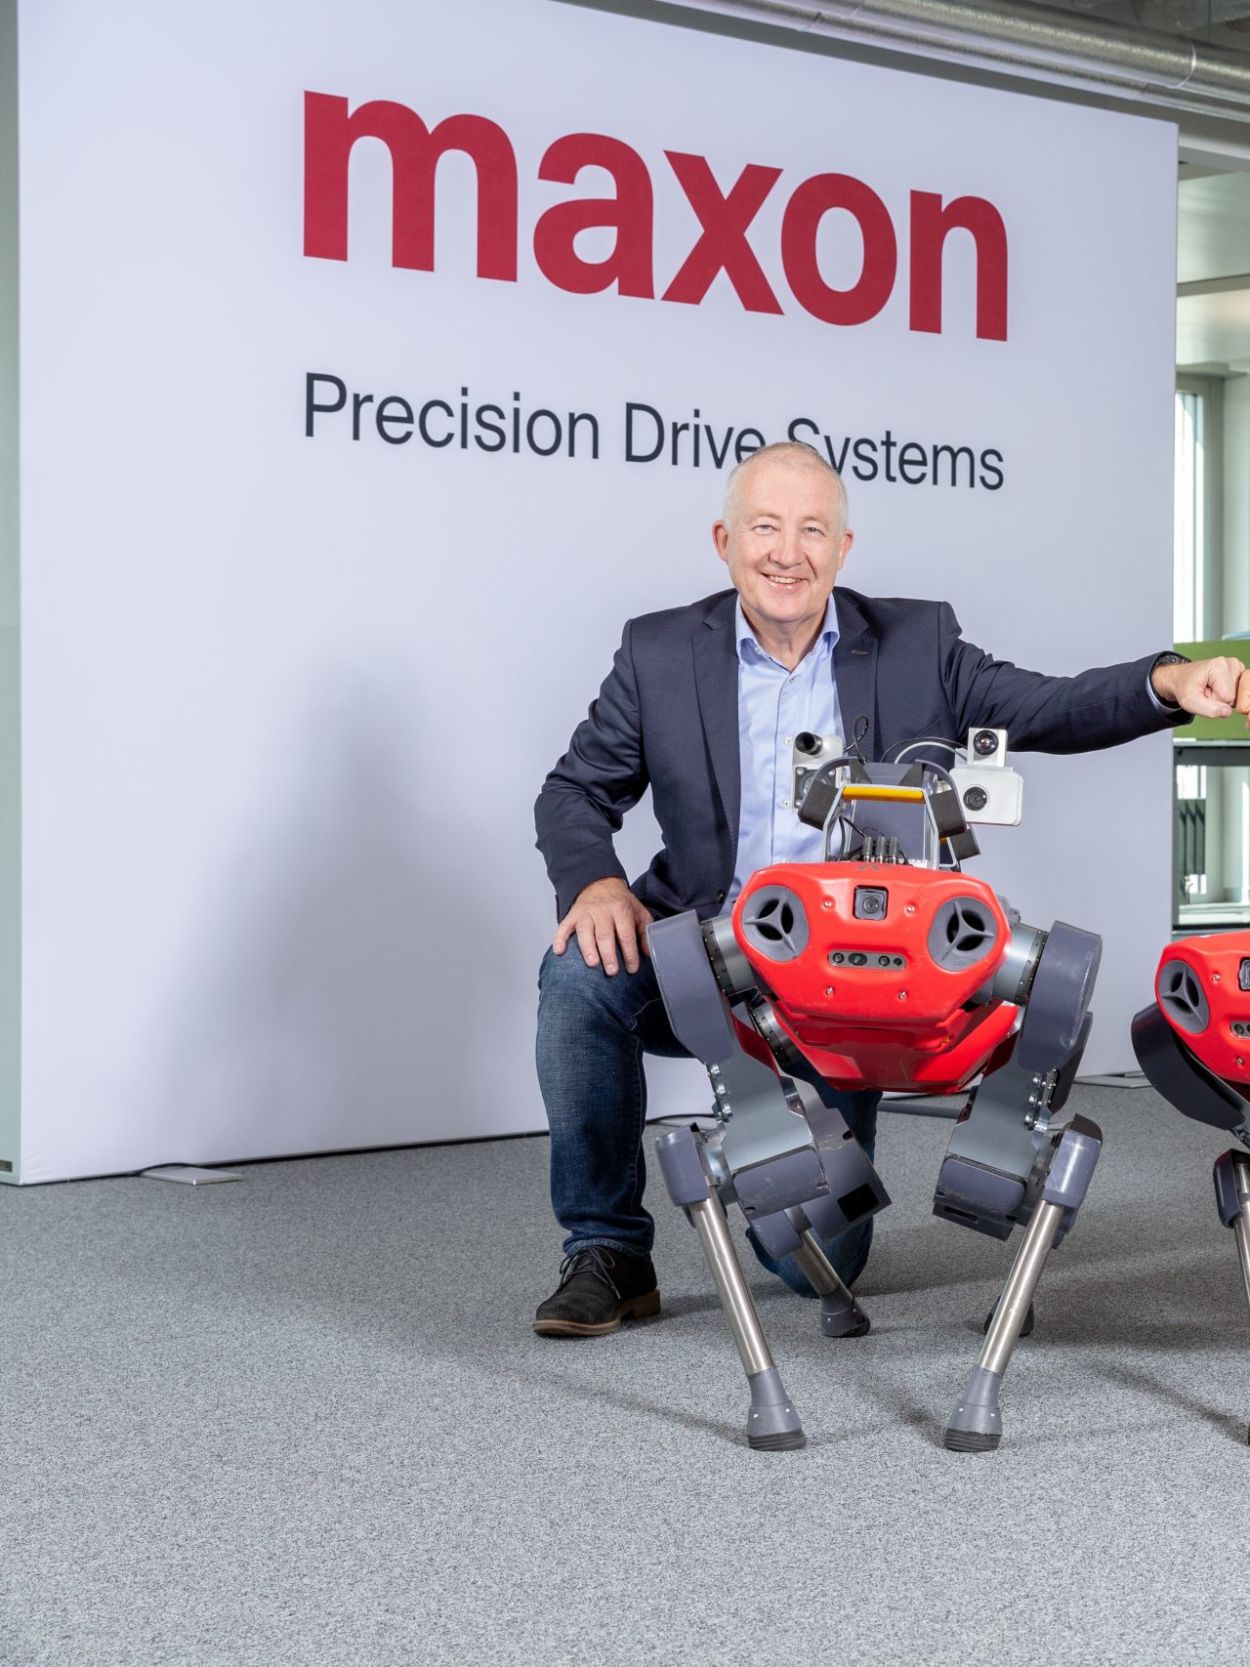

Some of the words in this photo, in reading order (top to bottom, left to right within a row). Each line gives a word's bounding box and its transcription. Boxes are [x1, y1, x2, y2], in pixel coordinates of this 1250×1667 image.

[304, 91, 1008, 341] maxon
[305, 372, 599, 460] Precision
[625, 402, 766, 470] Drive
